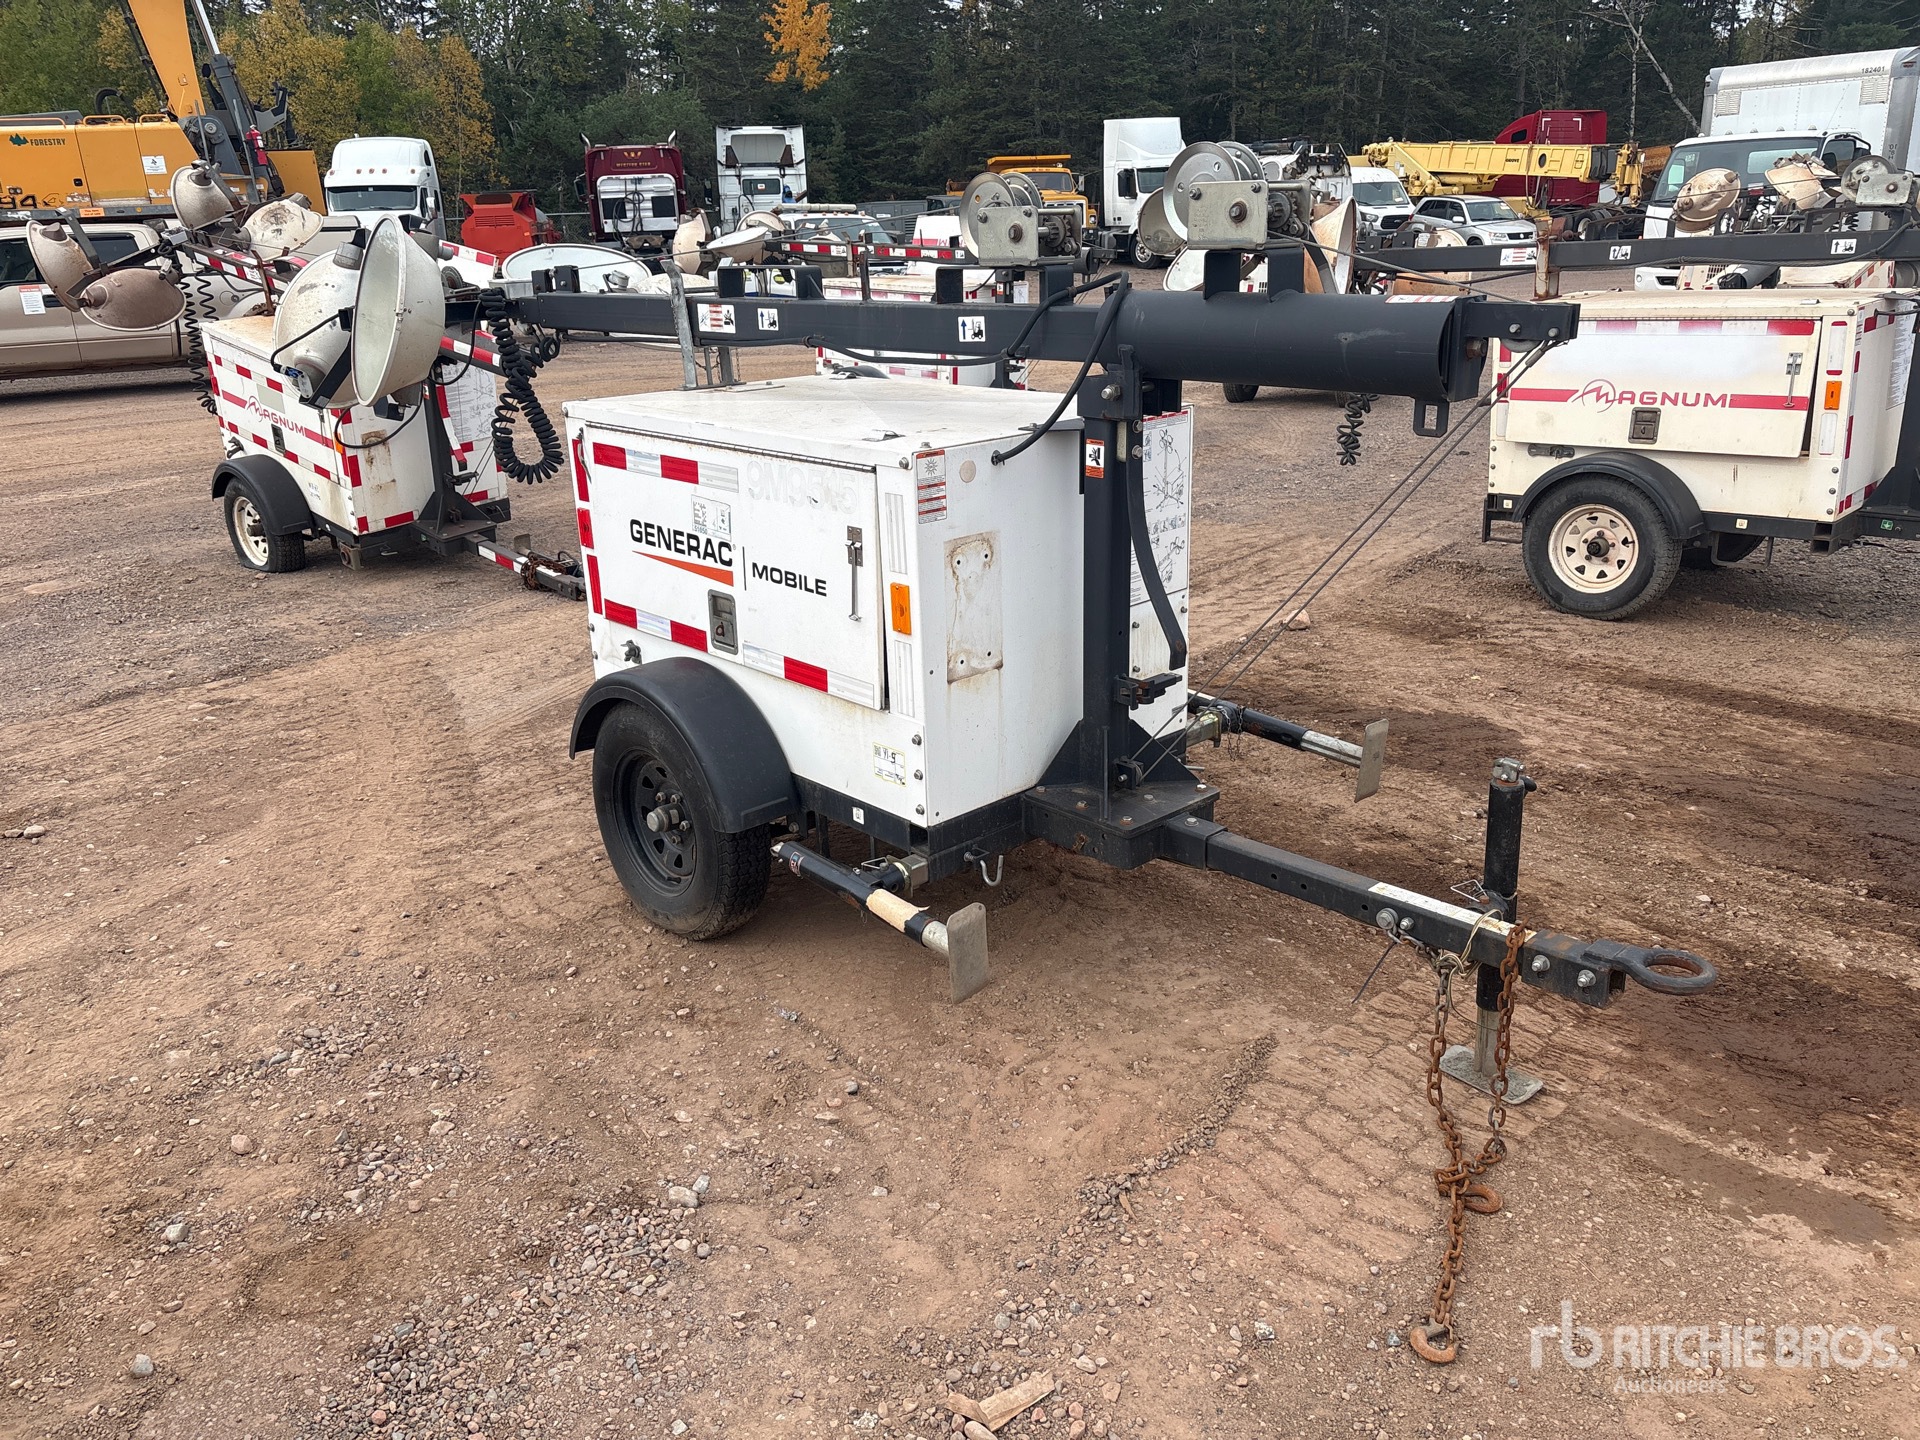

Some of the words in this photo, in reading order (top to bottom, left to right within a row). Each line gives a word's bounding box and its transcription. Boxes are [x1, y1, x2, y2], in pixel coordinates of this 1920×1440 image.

[1861, 66, 1885, 74] 182401
[30, 138, 66, 146] FORESTRY
[1572, 381, 1728, 411] MAGNUM
[247, 397, 305, 436] MAGNUM
[630, 518, 733, 567] GENERAC
[752, 562, 827, 597] MOBILE
